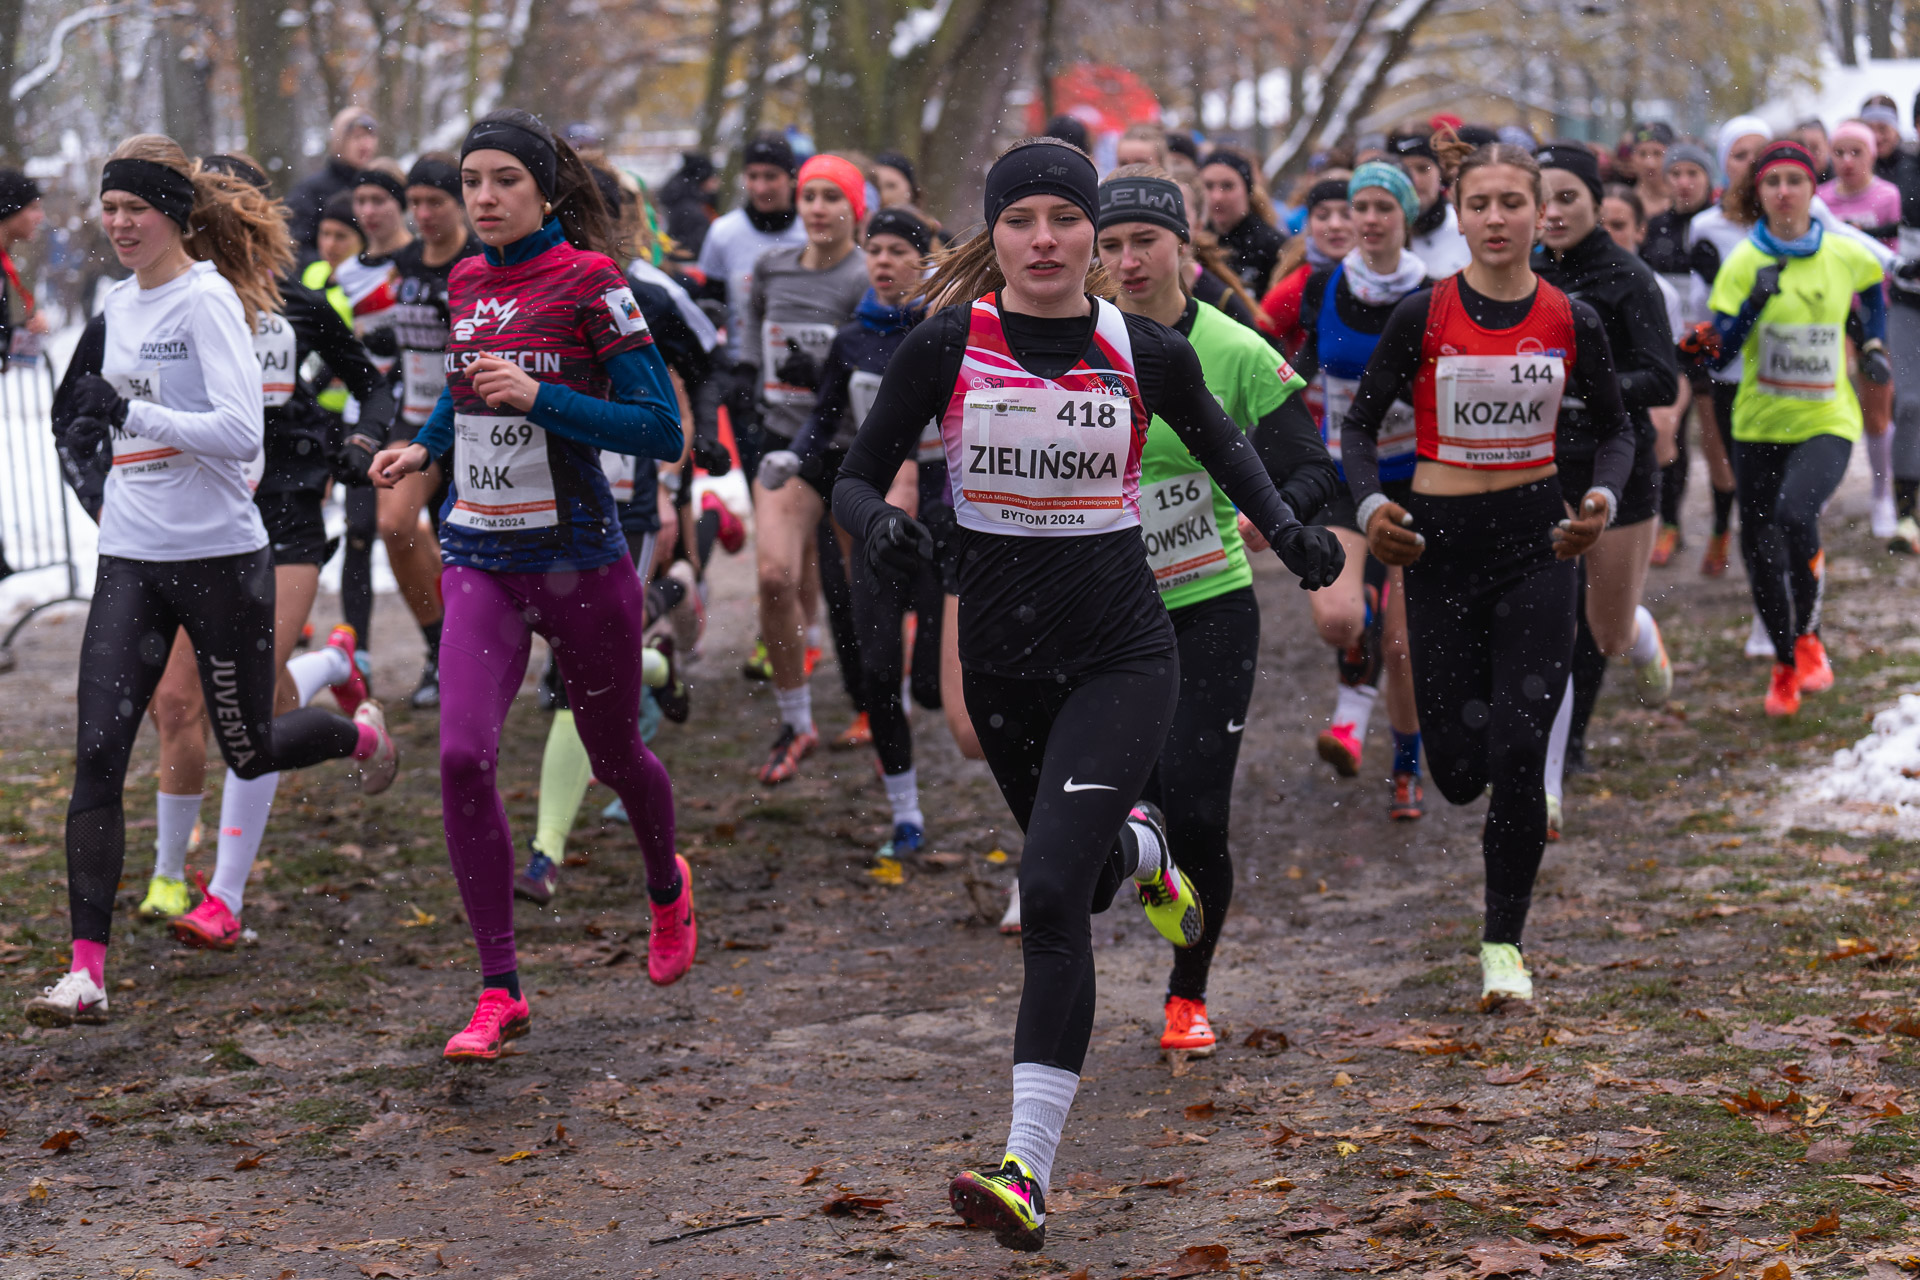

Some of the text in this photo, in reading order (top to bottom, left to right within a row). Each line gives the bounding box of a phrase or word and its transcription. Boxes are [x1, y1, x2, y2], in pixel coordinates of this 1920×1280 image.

[141, 342, 187, 353] JUVENTA
[1510, 364, 1553, 383] 144
[1057, 401, 1116, 428] 418
[1454, 402, 1543, 425] KOZAK
[490, 424, 533, 446] 669
[969, 443, 1118, 480] ZIELIŃSKA
[1466, 451, 1504, 460] BYTOM
[469, 464, 514, 490] RAK
[994, 494, 1028, 505] Mistrzostwa
[1155, 480, 1200, 511] 156
[469, 516, 525, 527] BYTOM 2024
[1001, 509, 1085, 525] BYTOM 2024
[1174, 572, 1199, 586] 2024
[210, 655, 256, 768] JUVENTA
